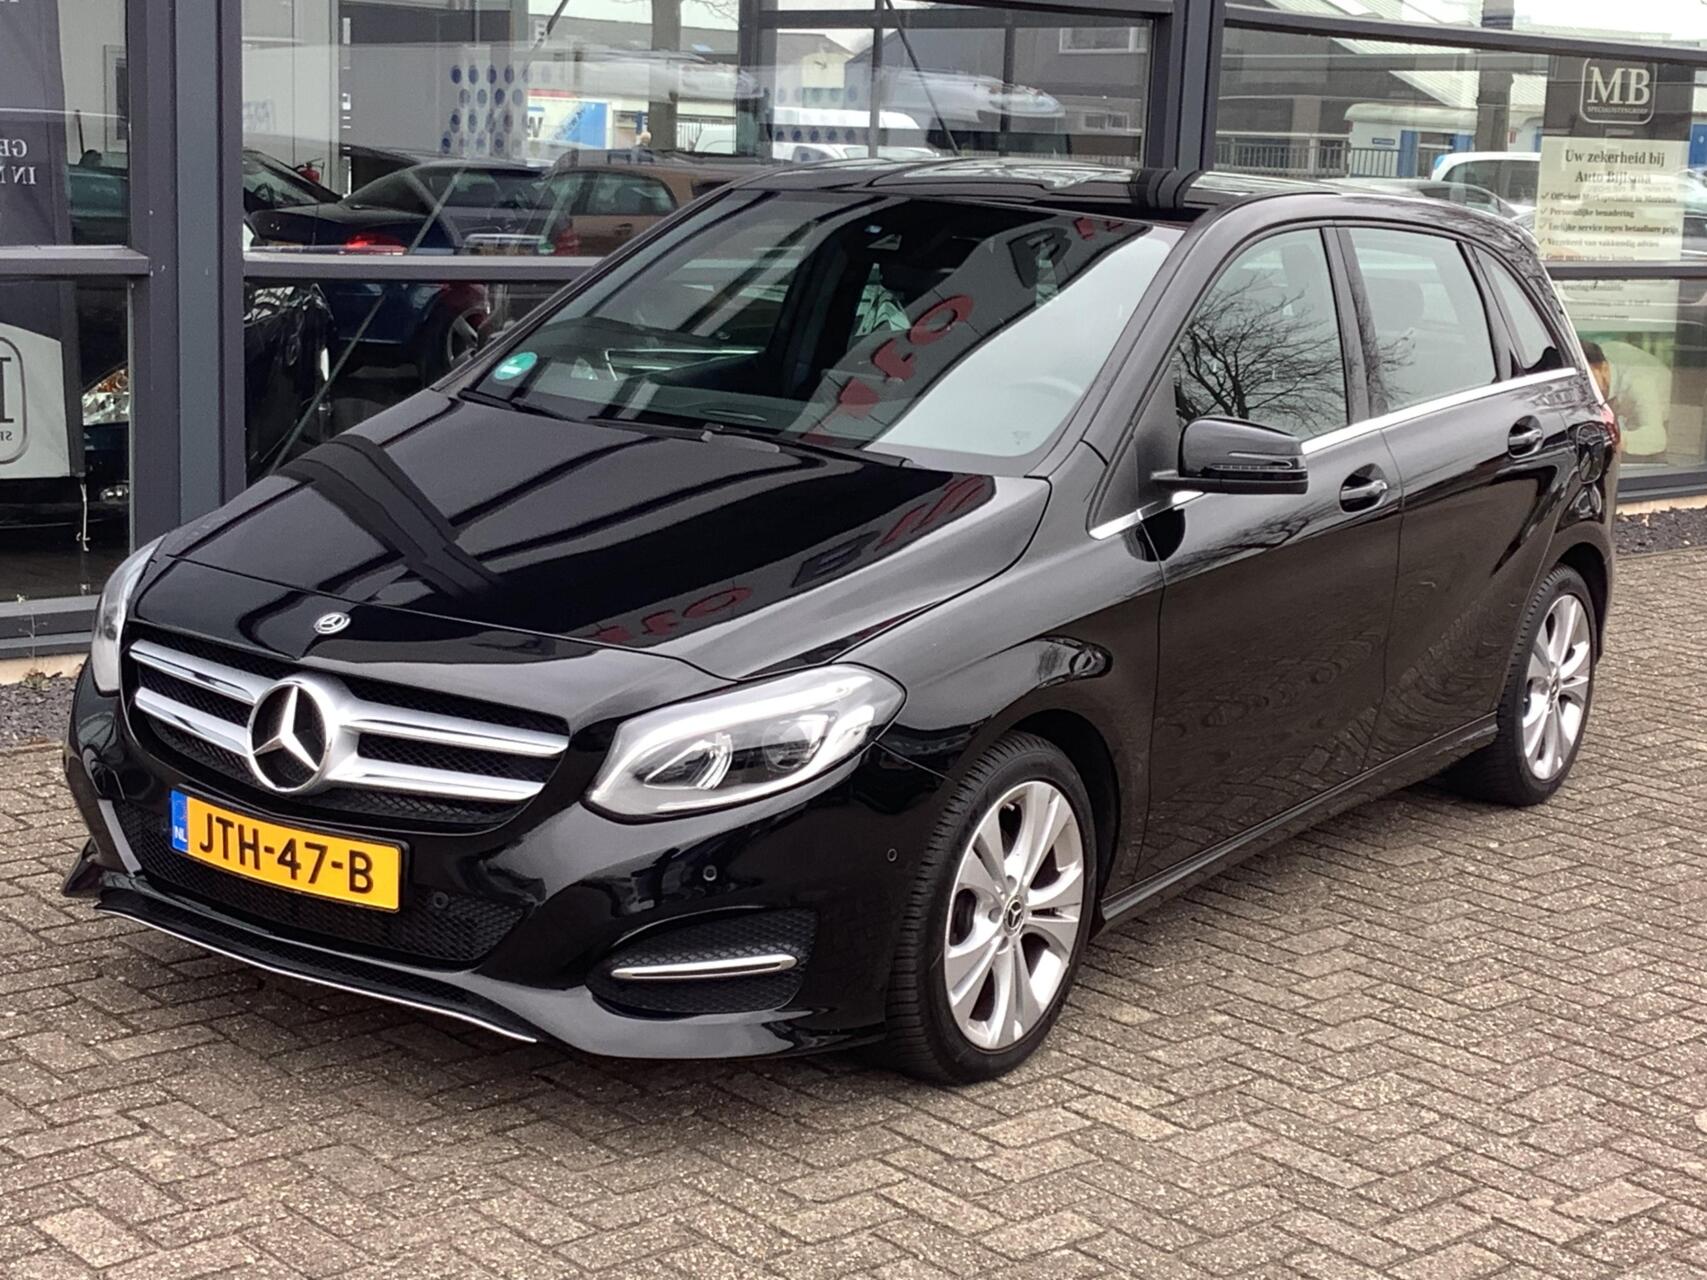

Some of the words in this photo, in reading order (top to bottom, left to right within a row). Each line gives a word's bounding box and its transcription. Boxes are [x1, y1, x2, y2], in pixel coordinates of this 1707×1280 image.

[1587, 66, 1651, 105] MB
[1566, 149, 1584, 162] Uw
[1587, 150, 1647, 165] zekerheid
[1649, 151, 1665, 168] bij
[1574, 170, 1603, 183] Auto
[174, 825, 188, 843] NL
[199, 812, 374, 895] JTH-47-B
